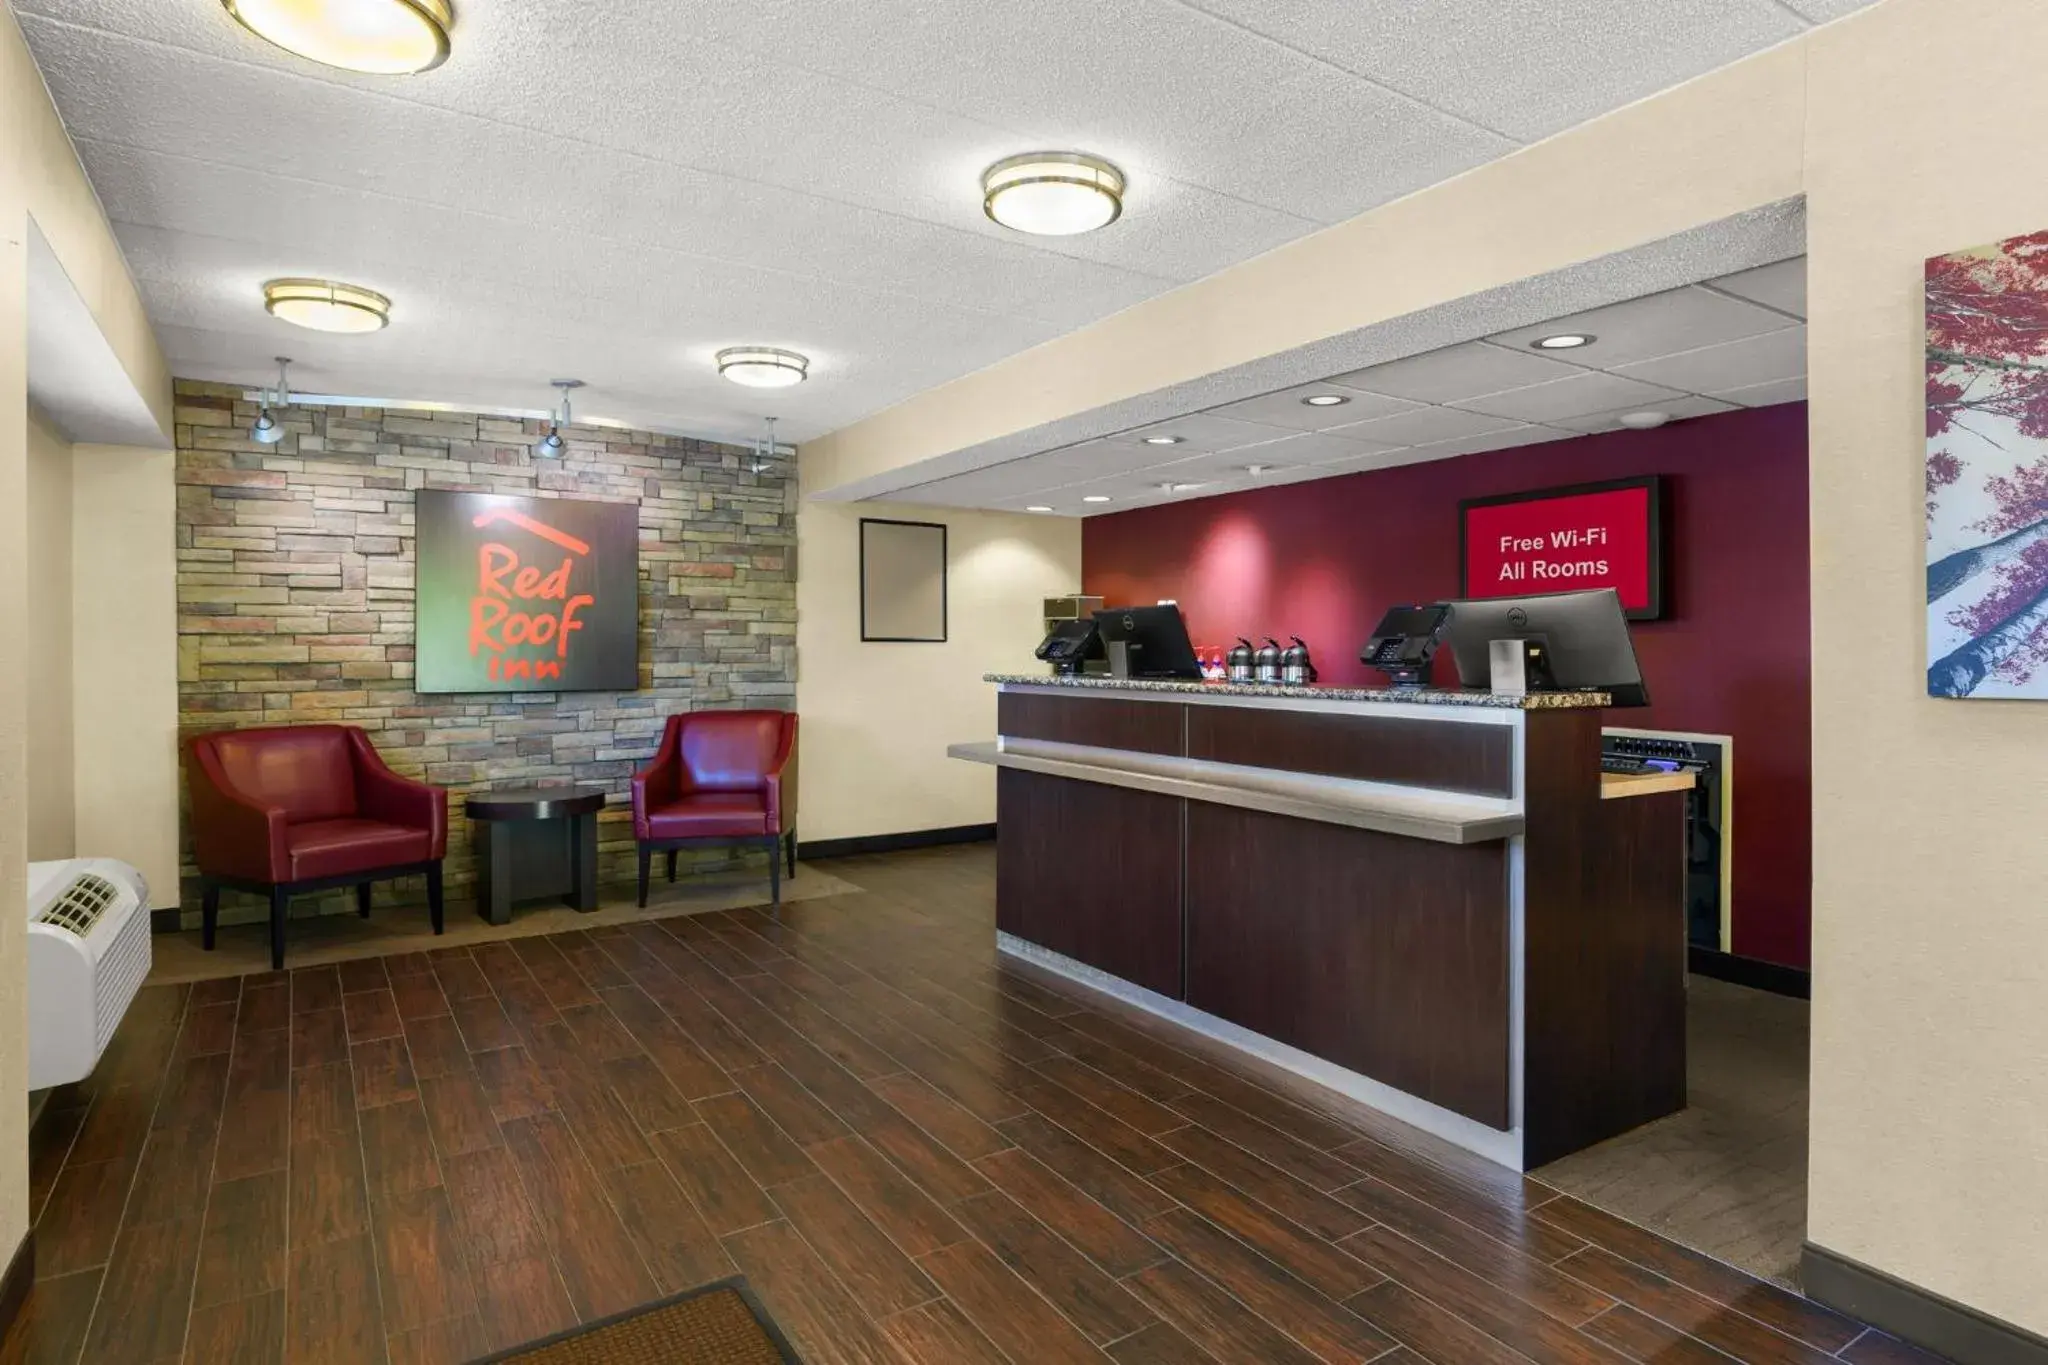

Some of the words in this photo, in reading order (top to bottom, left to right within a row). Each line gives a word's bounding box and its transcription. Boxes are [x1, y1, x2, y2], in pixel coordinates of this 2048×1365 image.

[1500, 536, 1544, 552] Free
[1551, 527, 1606, 548] Wi-Fi
[479, 543, 573, 599] Red
[1499, 561, 1525, 580] All
[1532, 560, 1609, 579] Rooms
[469, 594, 595, 657] Roof
